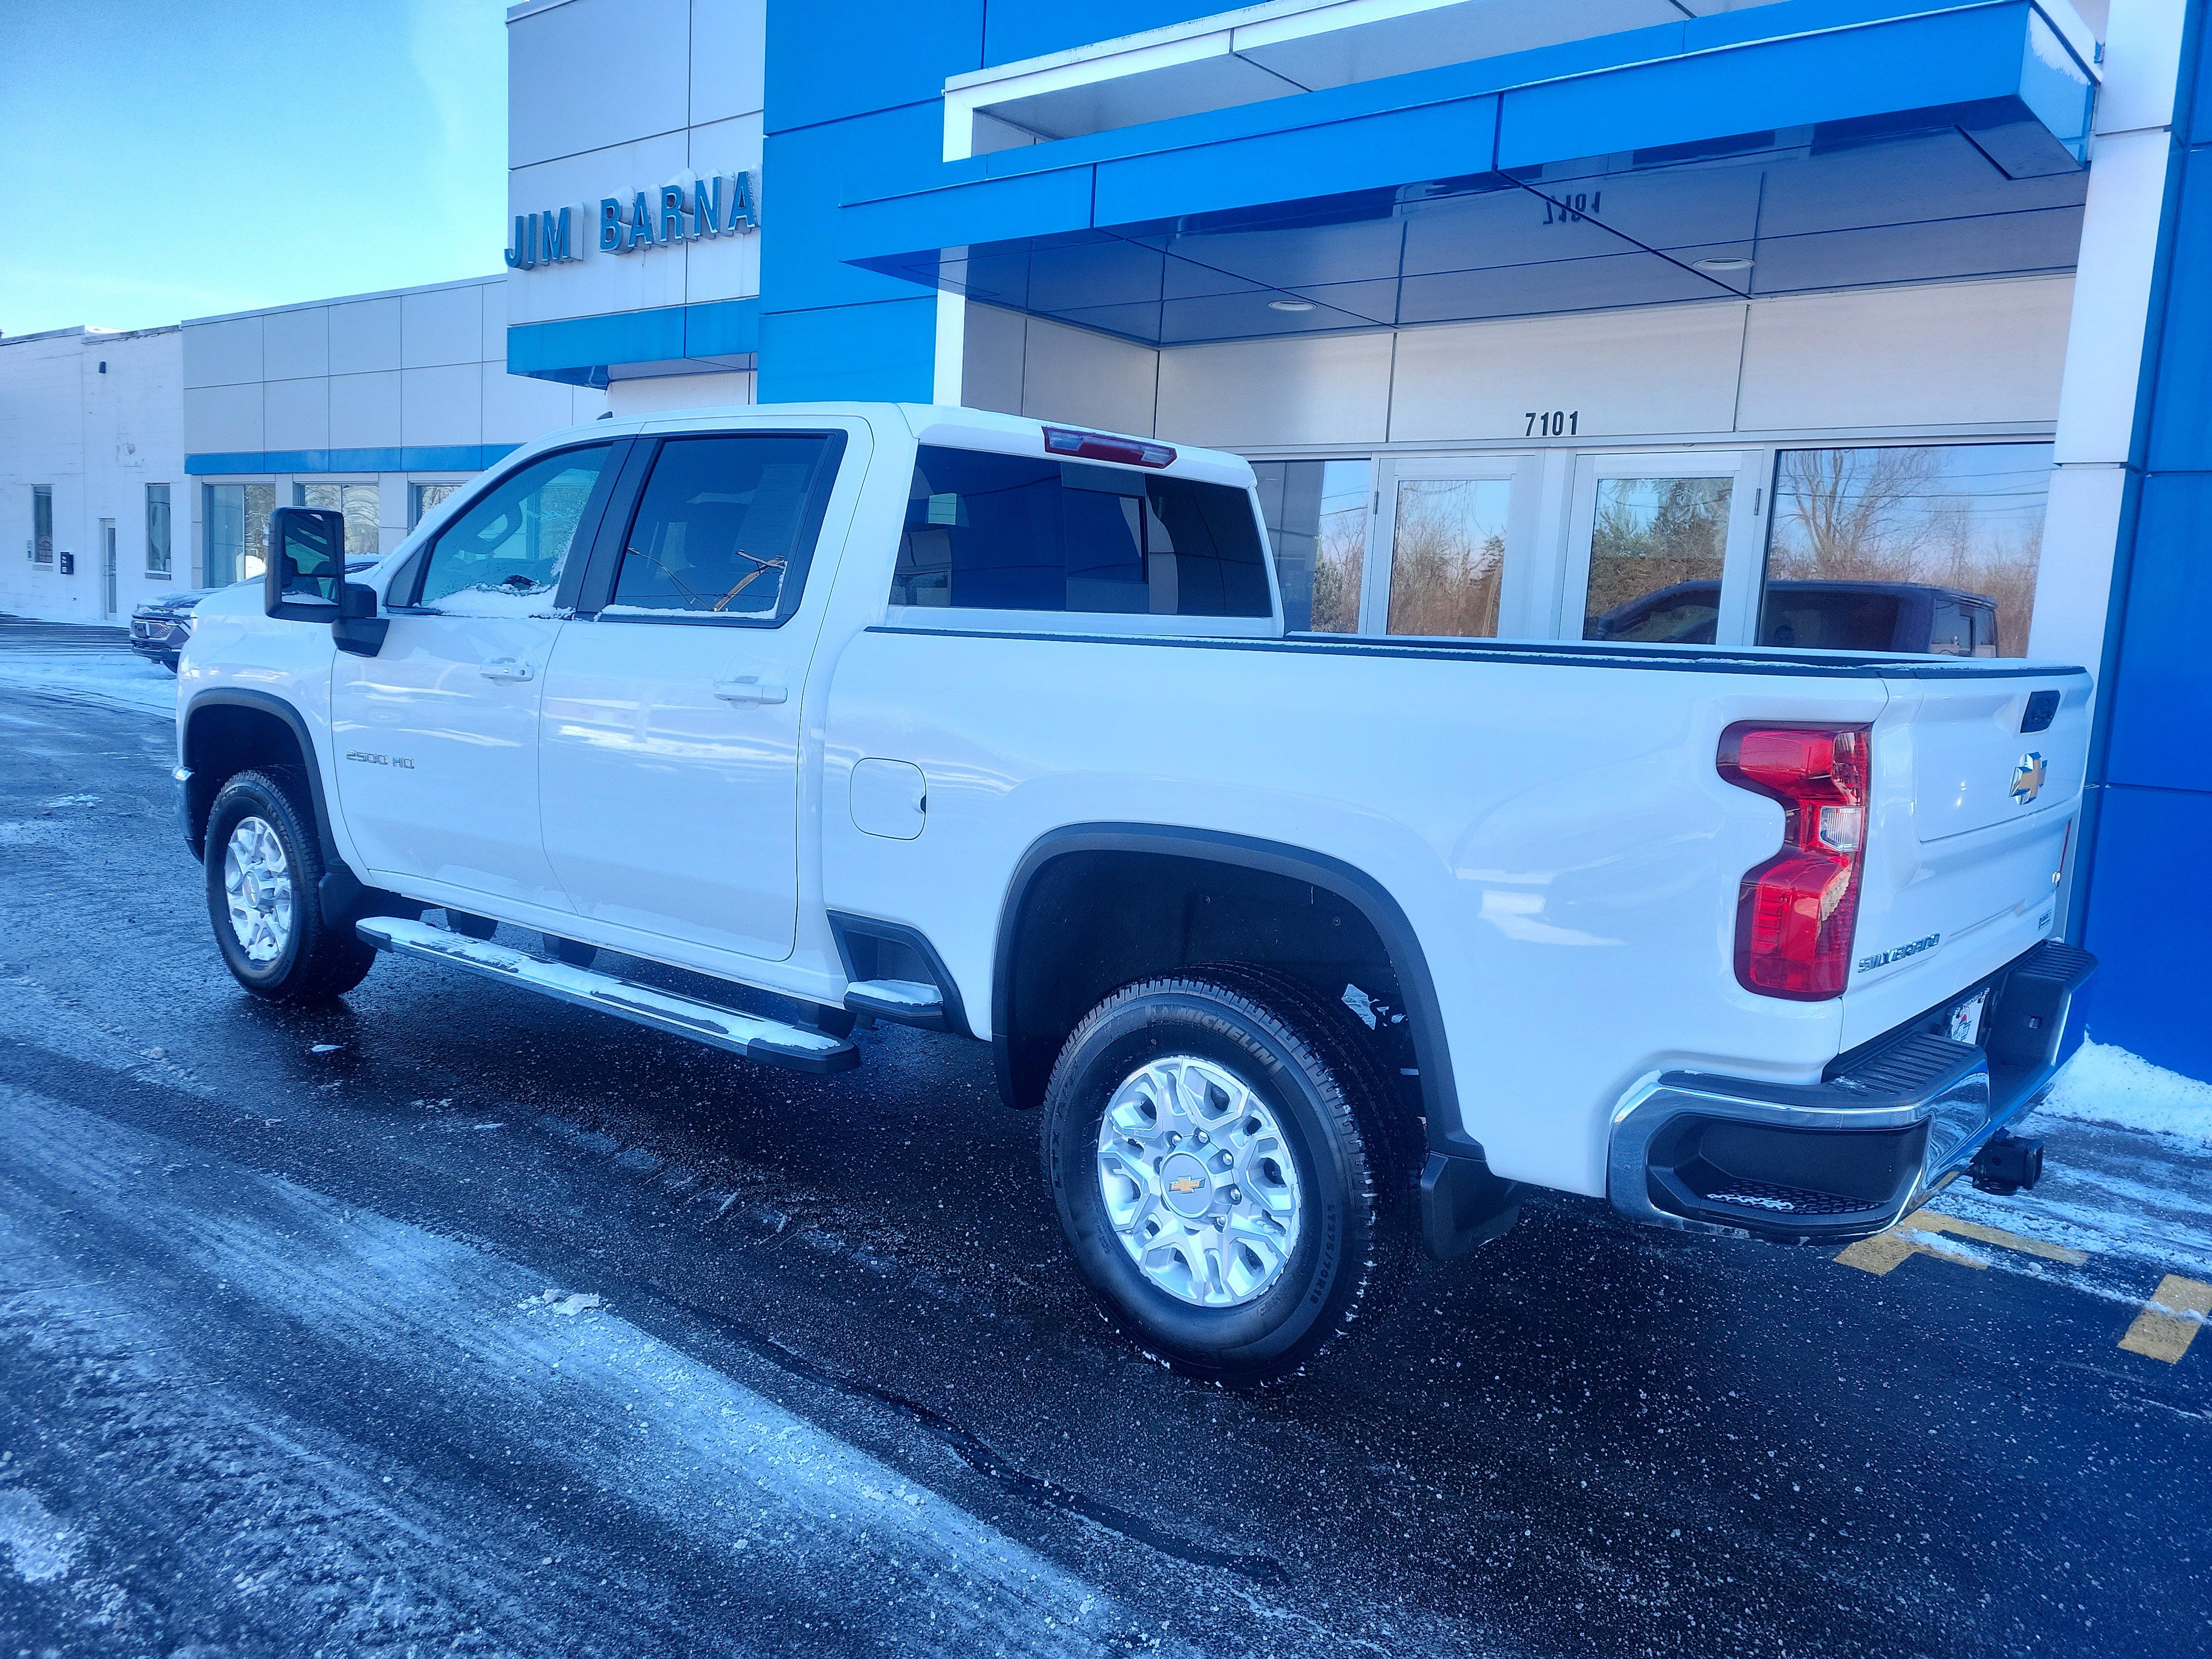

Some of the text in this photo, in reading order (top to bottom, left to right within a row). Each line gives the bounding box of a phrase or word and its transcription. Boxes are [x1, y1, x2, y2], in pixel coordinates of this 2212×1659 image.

[504, 171, 757, 268] JIM BARNA
[1525, 411, 1578, 436] 7101
[346, 750, 415, 769] 2500 HD
[1858, 933, 1940, 973] SILVERADO
[1177, 1008, 1277, 1065] MICHELIN
